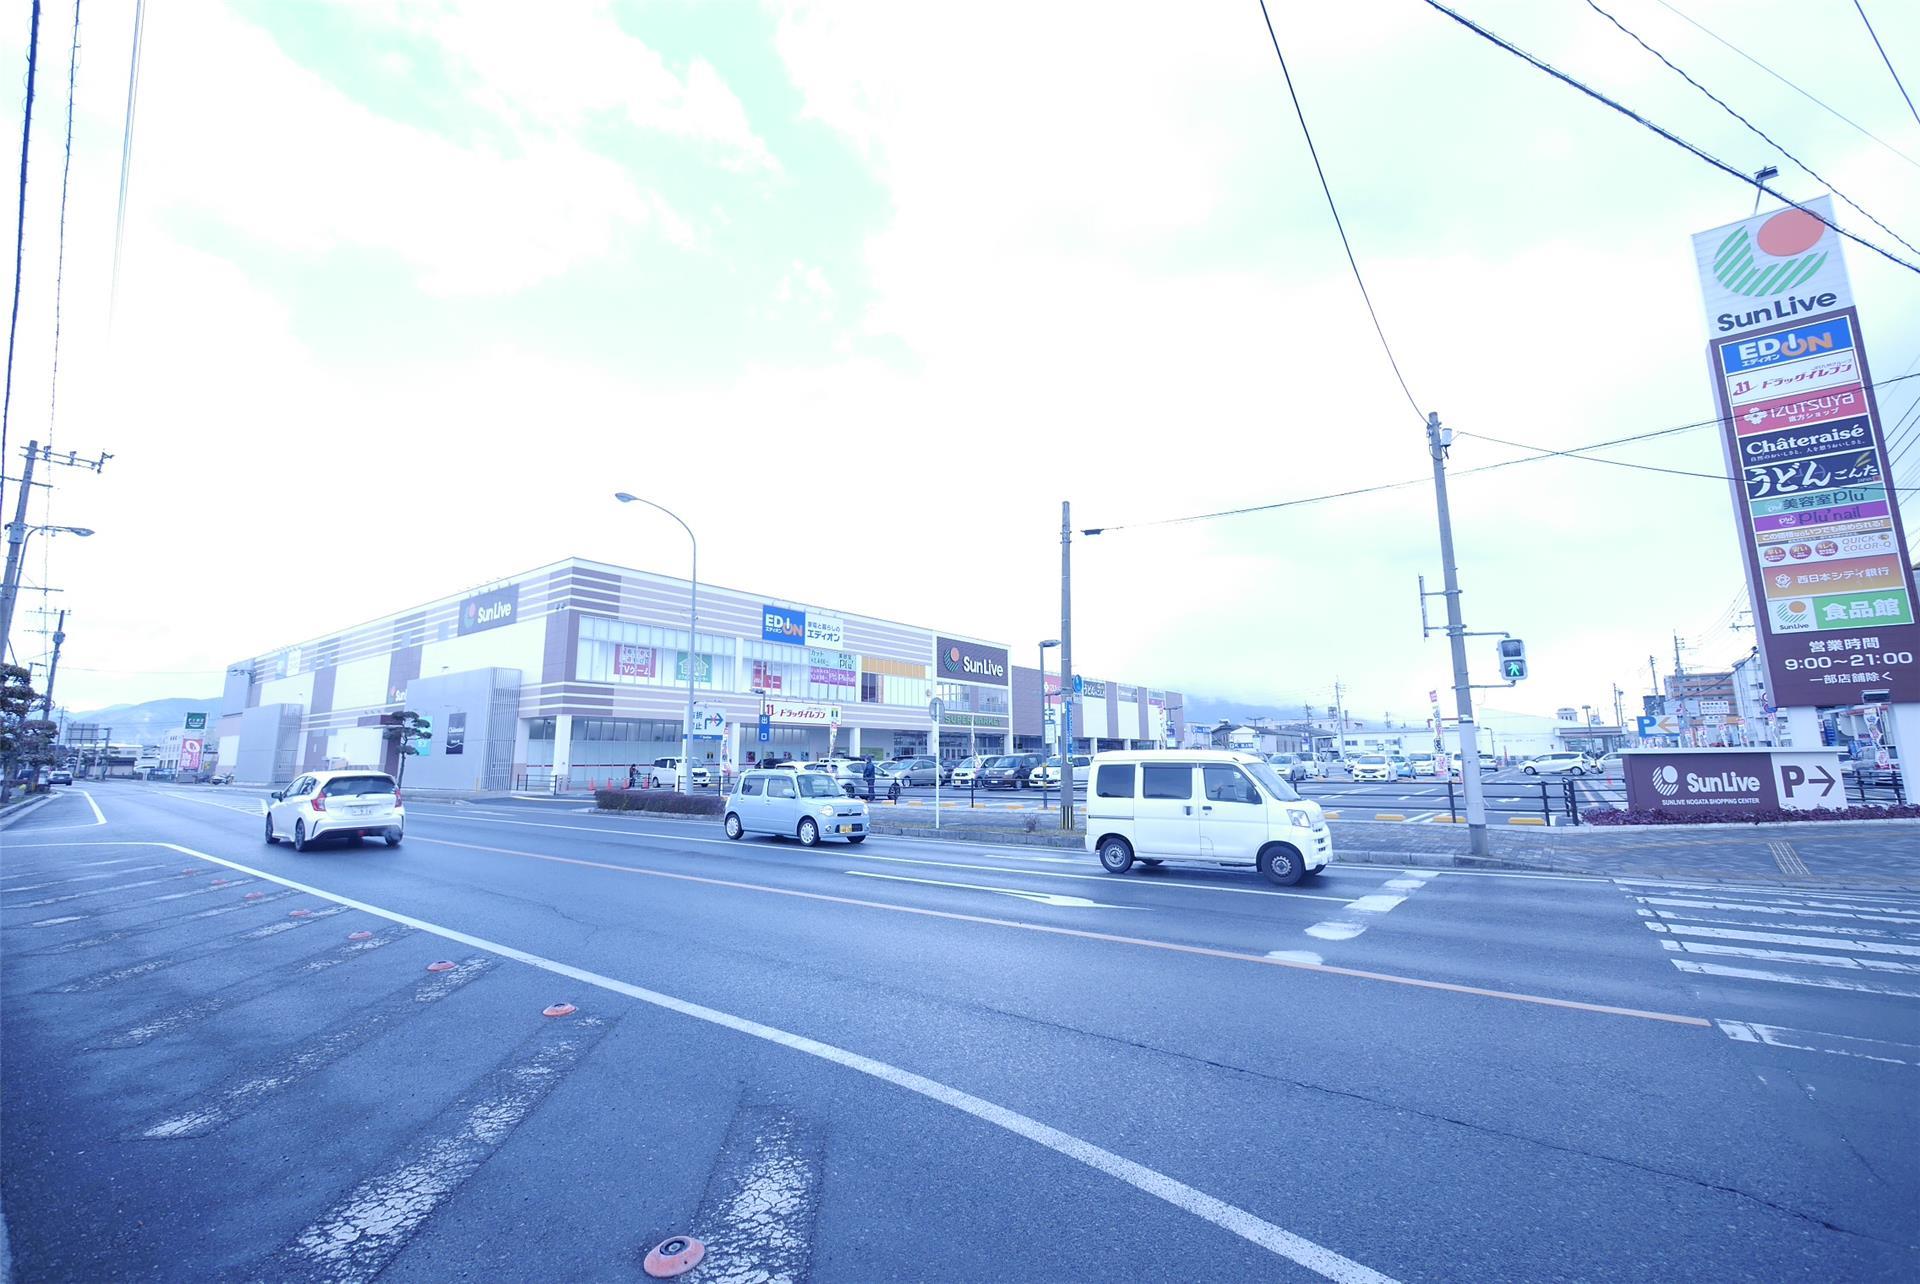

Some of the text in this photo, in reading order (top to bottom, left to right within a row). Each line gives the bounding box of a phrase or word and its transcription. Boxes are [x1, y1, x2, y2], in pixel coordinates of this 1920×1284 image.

[1739, 332, 1833, 361] EDION
[1746, 424, 1865, 455] Châteraisé
[1746, 461, 1831, 496] うどん
[1842, 534, 1875, 546] QUICK
[1797, 566, 1890, 584] 西日本シティ銀行
[477, 600, 512, 624] SunLive
[1821, 598, 1900, 621] 食品館
[765, 614, 803, 637] EDION
[807, 629, 840, 642] エディオン
[1808, 637, 1880, 653] 営業時間
[963, 656, 1003, 677] SunLive
[1809, 672, 1893, 684] 一部店舗除く
[761, 716, 768, 740] 出口
[1686, 771, 1761, 793] SunLive
[1780, 766, 1805, 798] P
